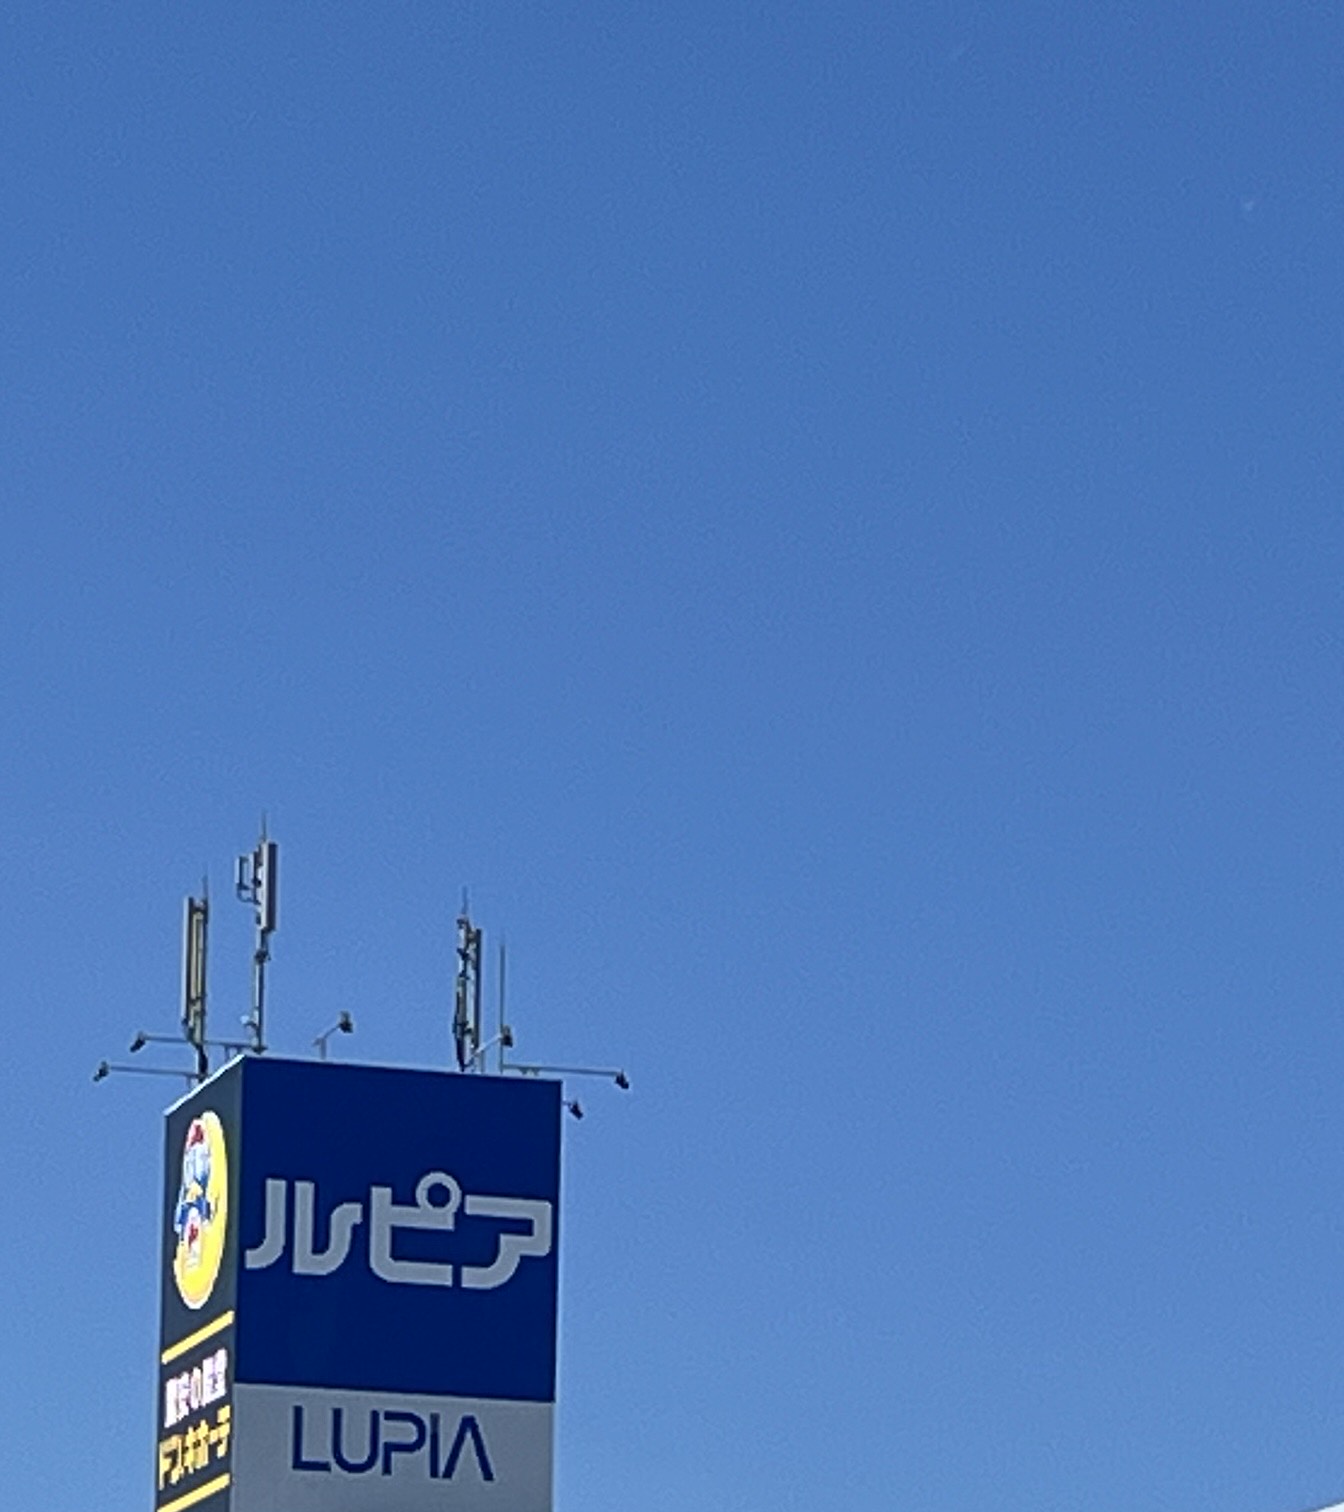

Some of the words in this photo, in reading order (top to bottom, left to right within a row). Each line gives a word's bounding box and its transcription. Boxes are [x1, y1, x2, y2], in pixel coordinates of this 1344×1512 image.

[245, 1171, 552, 1289] ルピア
[291, 1405, 494, 1482] LUPIA
